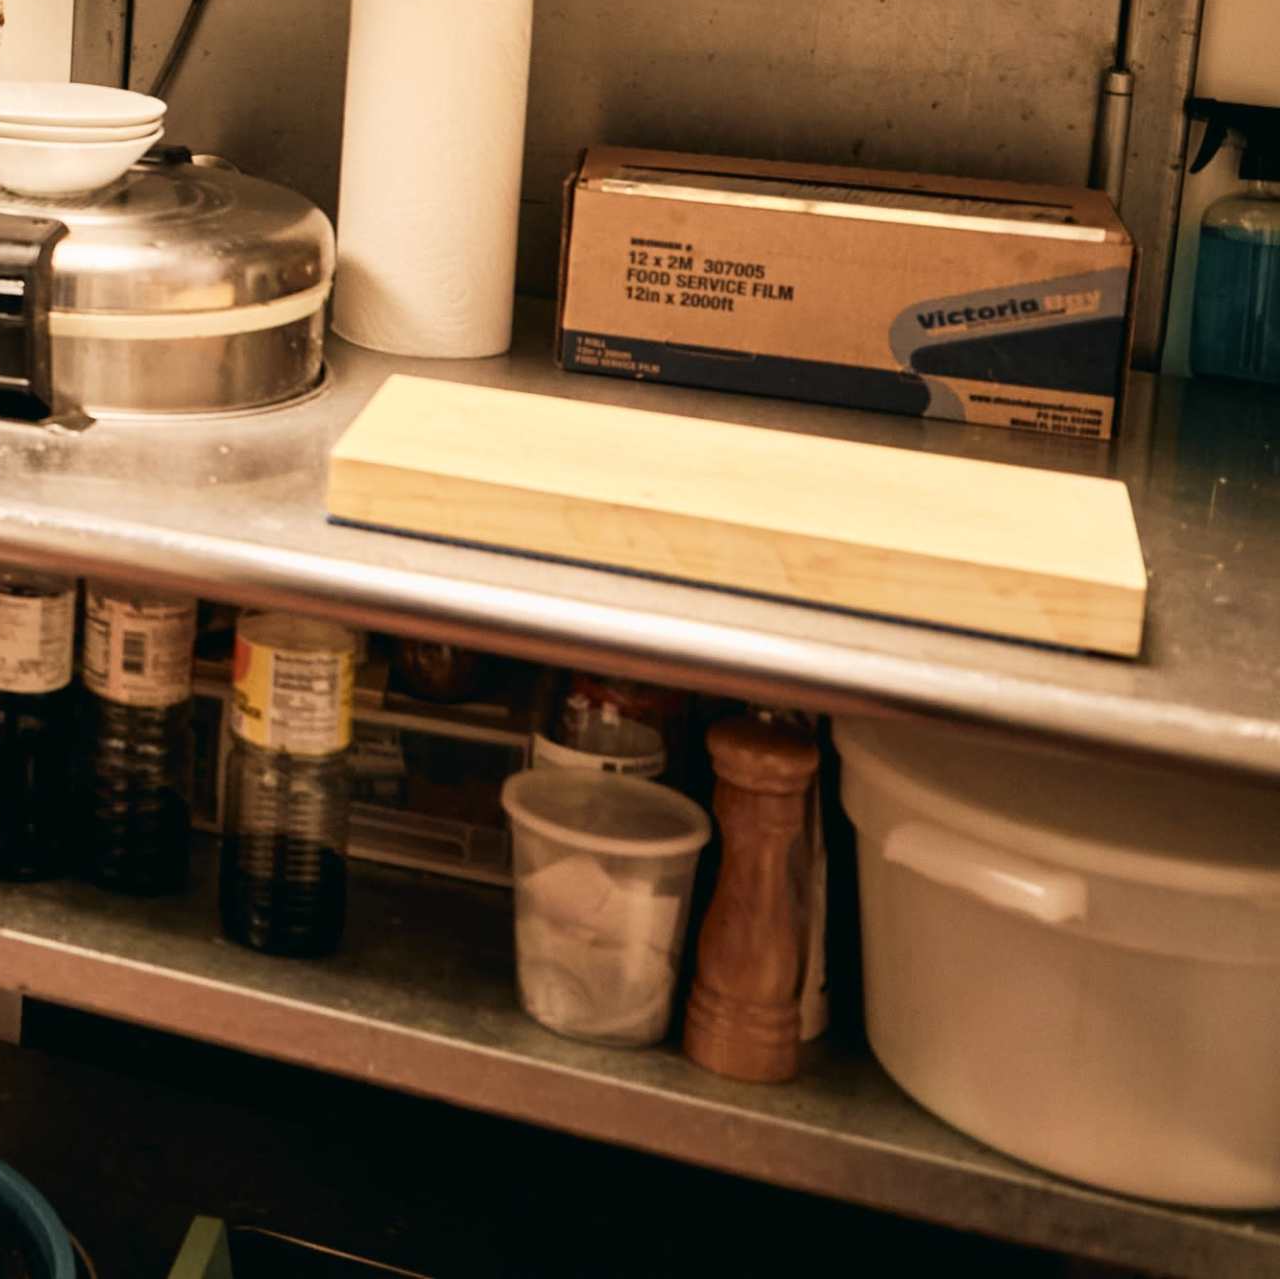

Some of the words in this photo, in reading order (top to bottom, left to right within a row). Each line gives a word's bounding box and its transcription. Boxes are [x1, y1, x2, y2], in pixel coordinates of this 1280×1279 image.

[628, 250, 649, 267] 12
[653, 255, 662, 268] x
[667, 255, 694, 271] 2M
[703, 259, 766, 279] 307005
[626, 268, 671, 286] FOOD
[676, 274, 747, 296] SERVICE
[752, 283, 795, 301] FILM
[626, 286, 660, 303] 12in
[665, 293, 674, 305] x
[679, 292, 736, 312] 2000ft
[916, 296, 1040, 330] Victoria
